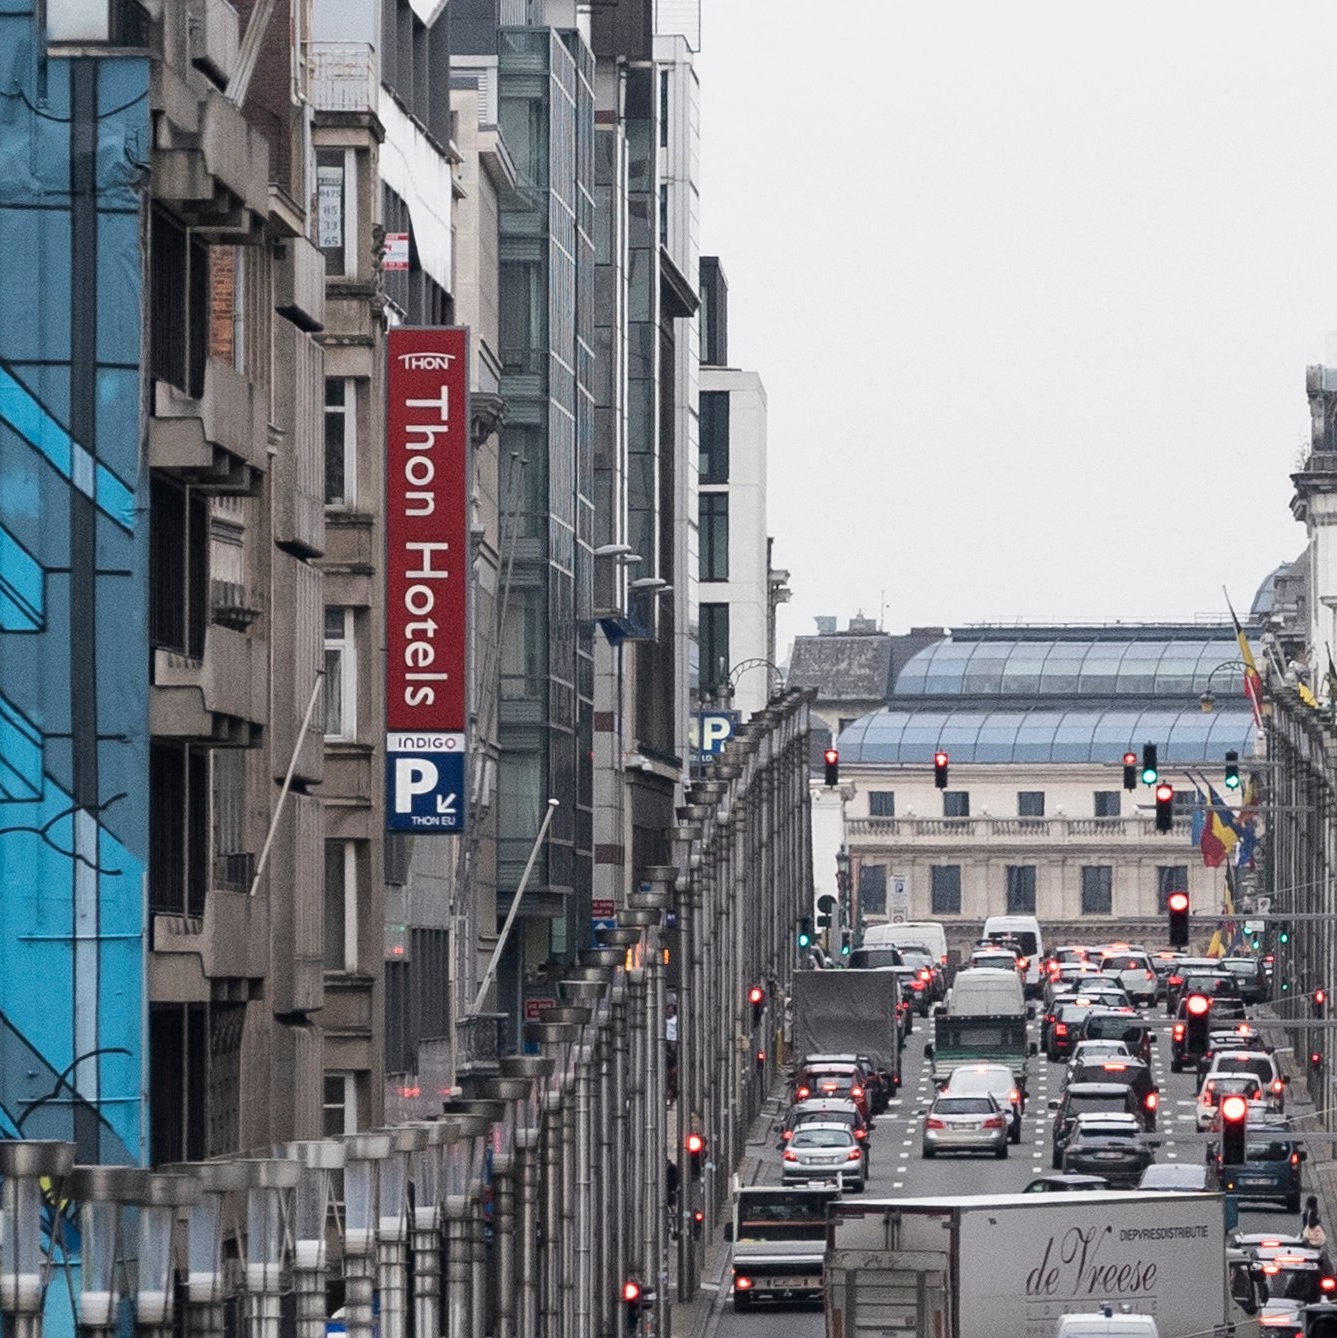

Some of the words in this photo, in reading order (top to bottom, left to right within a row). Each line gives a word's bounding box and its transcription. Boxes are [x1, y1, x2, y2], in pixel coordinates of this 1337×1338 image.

[398, 352, 456, 370] THON
[405, 385, 449, 516] Thon
[405, 542, 448, 706] Hotels
[399, 737, 456, 750] INDIGO
[395, 758, 439, 814] P
[411, 817, 439, 826] THON
[442, 817, 456, 826] EU
[1120, 1225, 1209, 1241] DIEPVRIESDISTRIBUTIE
[1026, 1237, 1060, 1296] de
[1061, 1225, 1158, 1296] Vreese
